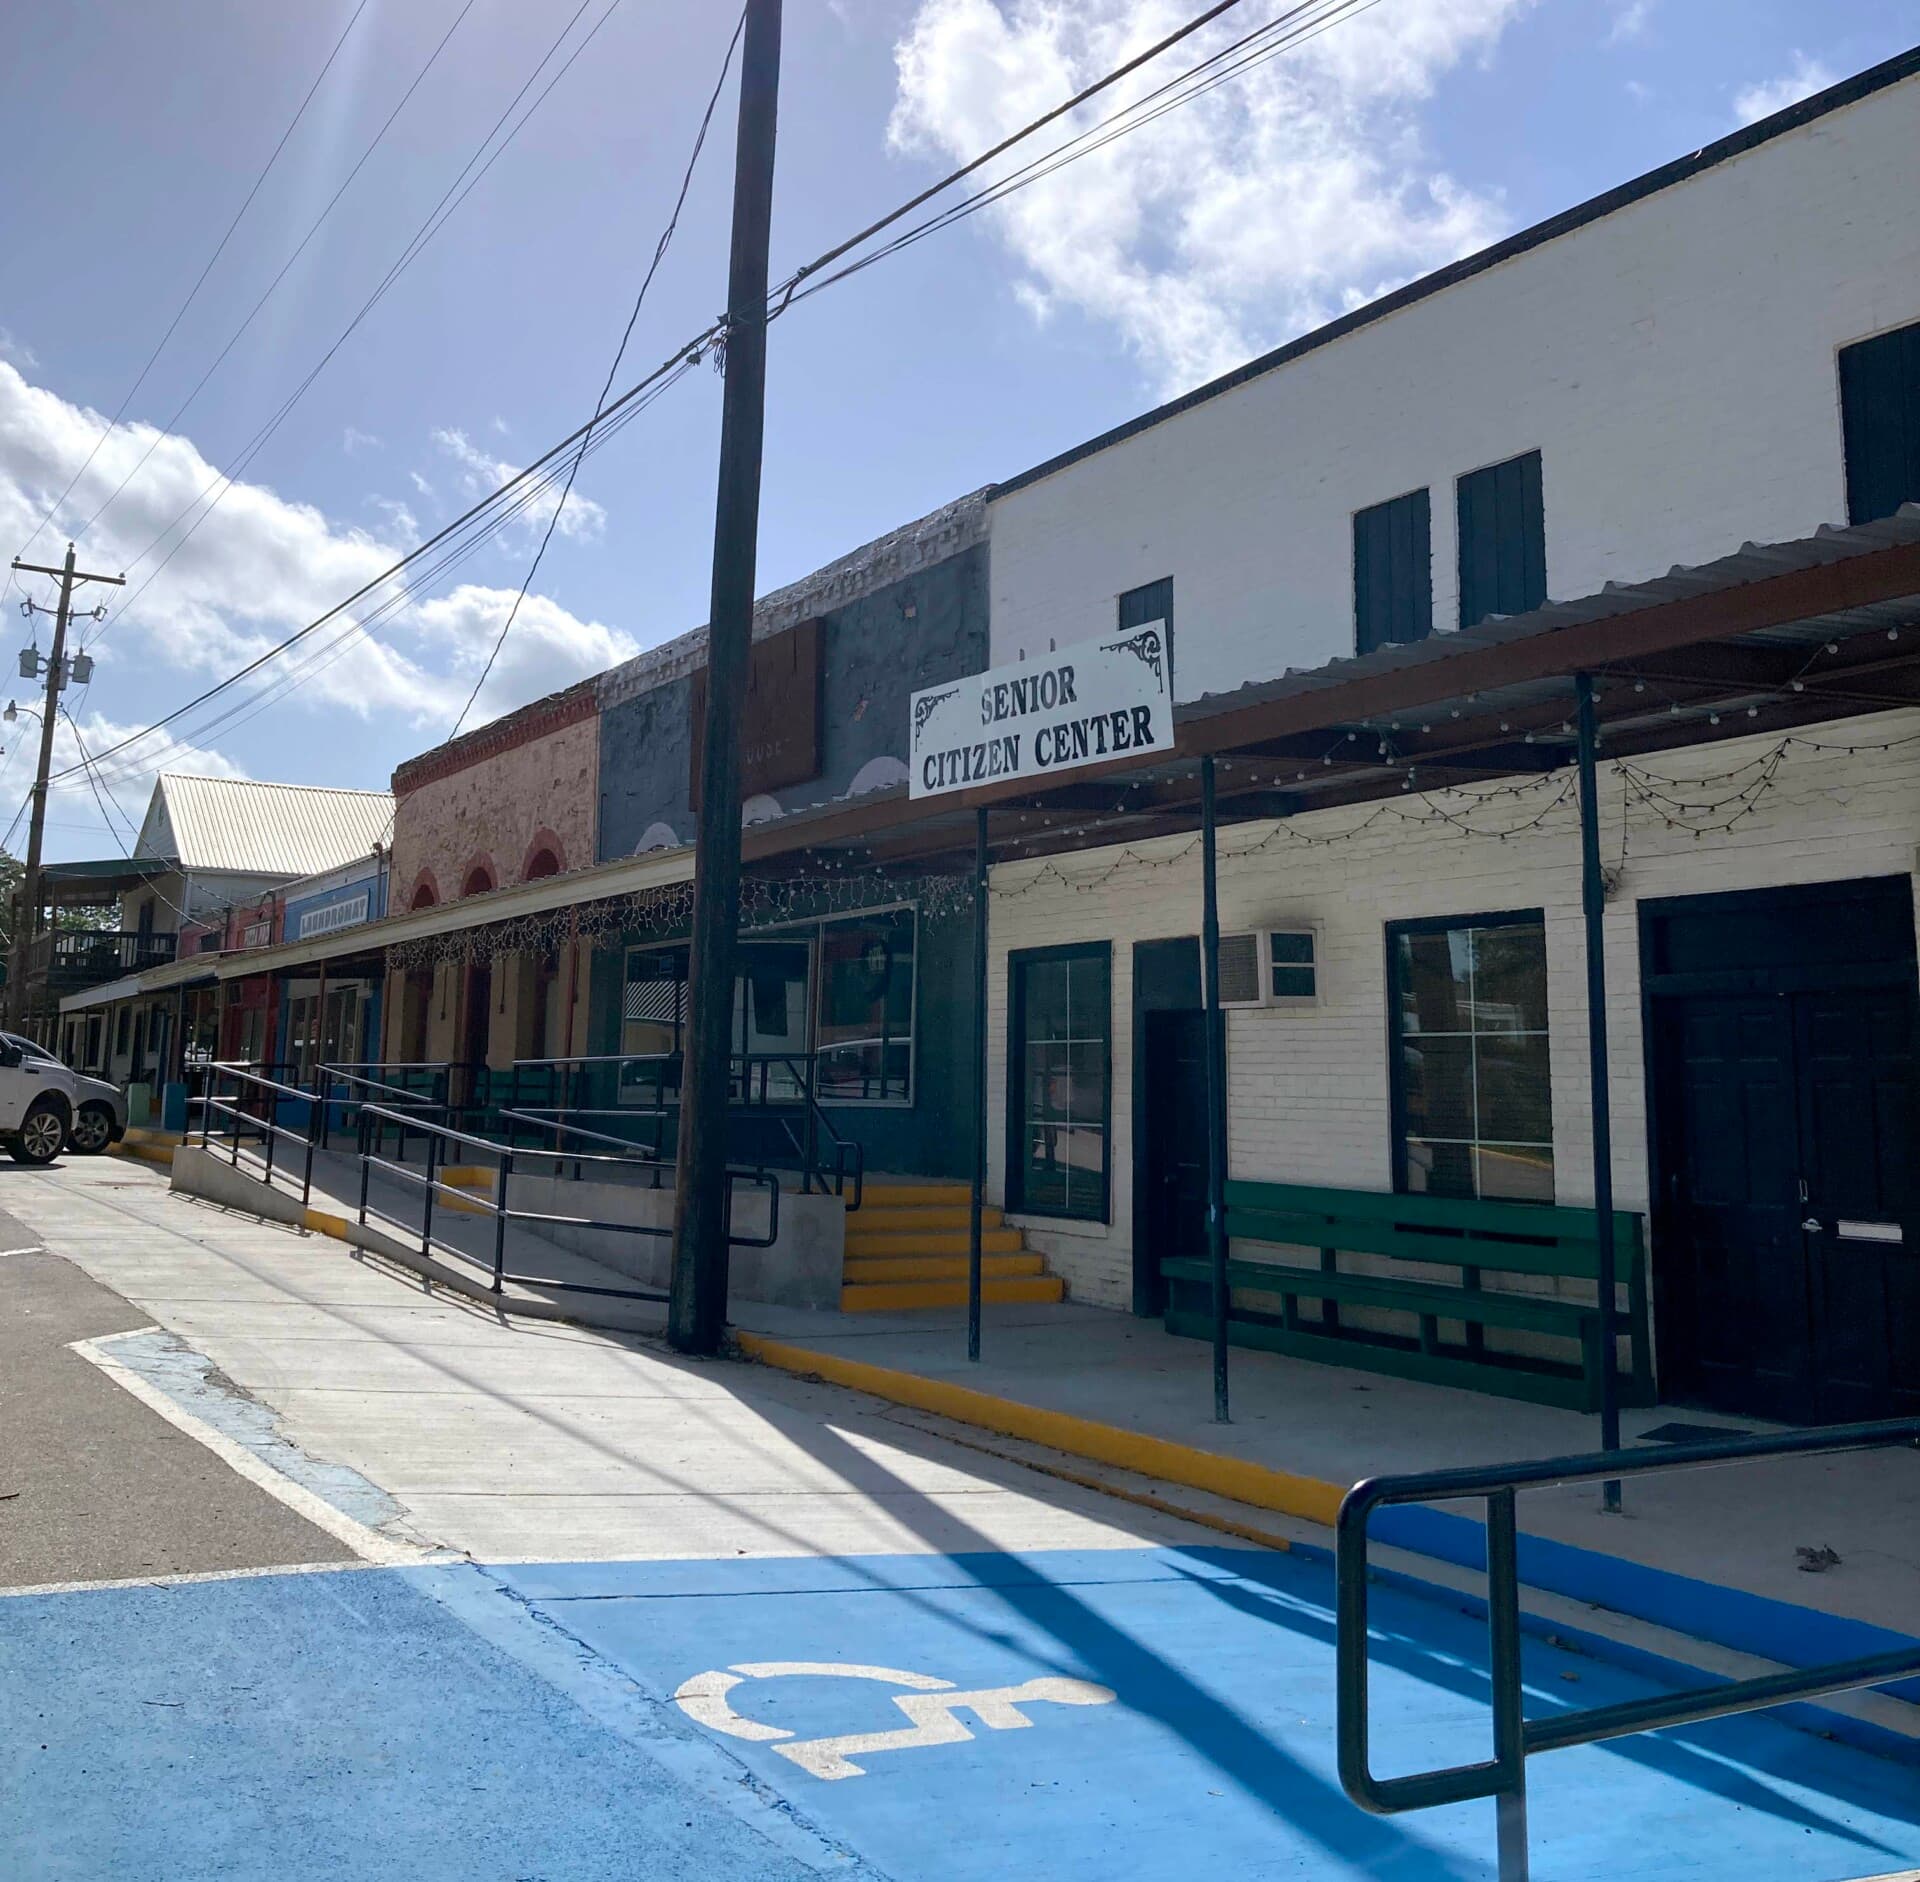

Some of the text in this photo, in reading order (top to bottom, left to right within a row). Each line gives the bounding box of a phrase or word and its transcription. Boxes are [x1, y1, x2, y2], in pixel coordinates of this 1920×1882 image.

[981, 665, 1077, 725] SENIOR
[923, 704, 1155, 790] CITIZEN CENTER
